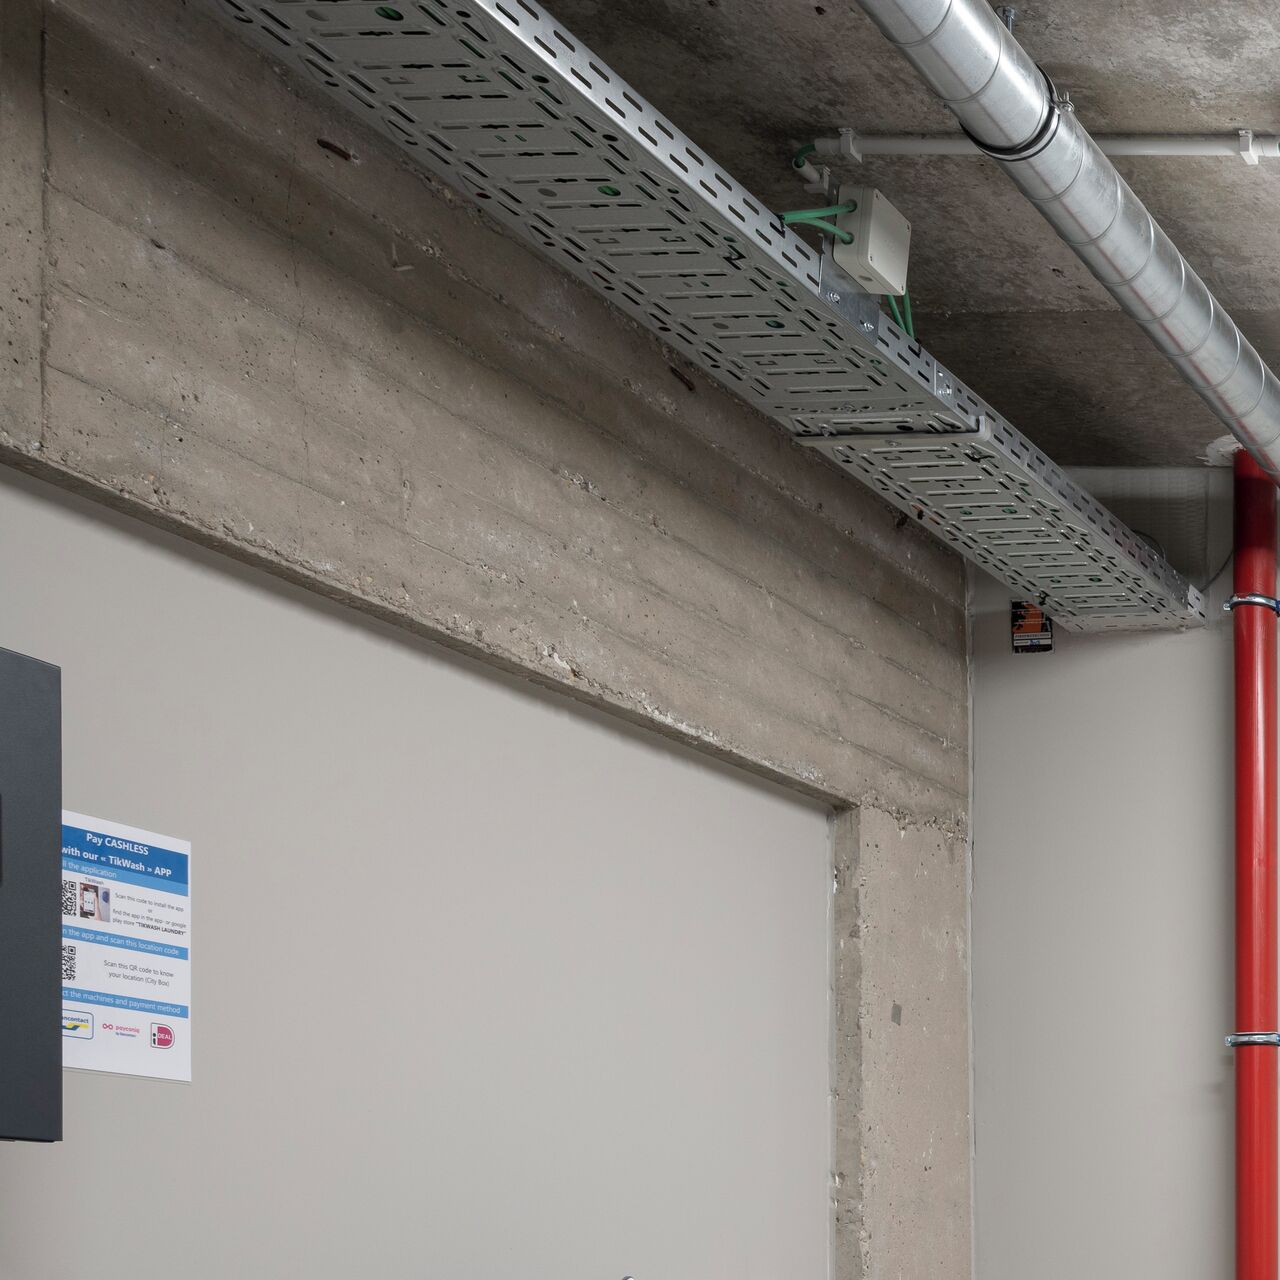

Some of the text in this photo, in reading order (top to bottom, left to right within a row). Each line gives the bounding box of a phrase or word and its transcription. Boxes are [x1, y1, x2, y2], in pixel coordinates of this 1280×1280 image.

[86, 833, 149, 855] Pay CASHLESS
[62, 846, 80, 857] with
[82, 852, 99, 860] our
[108, 855, 145, 872] TikWash
[154, 866, 172, 877] APP
[68, 862, 80, 870] the
[81, 865, 117, 879] application
[68, 928, 80, 937] the
[81, 932, 95, 941] app
[96, 934, 109, 943] and
[110, 936, 125, 946] scan
[126, 939, 138, 948] this
[138, 941, 163, 953] location
[164, 946, 179, 955] code
[103, 959, 117, 968] Scan
[118, 962, 128, 970] this
[160, 969, 174, 977] know
[122, 972, 144, 982] location
[70, 989, 81, 999] the
[83, 992, 114, 1004] machines
[115, 997, 128, 1006] and
[129, 1000, 156, 1011] payment
[157, 1004, 181, 1014] method
[61, 1015, 89, 1024] ncontact
